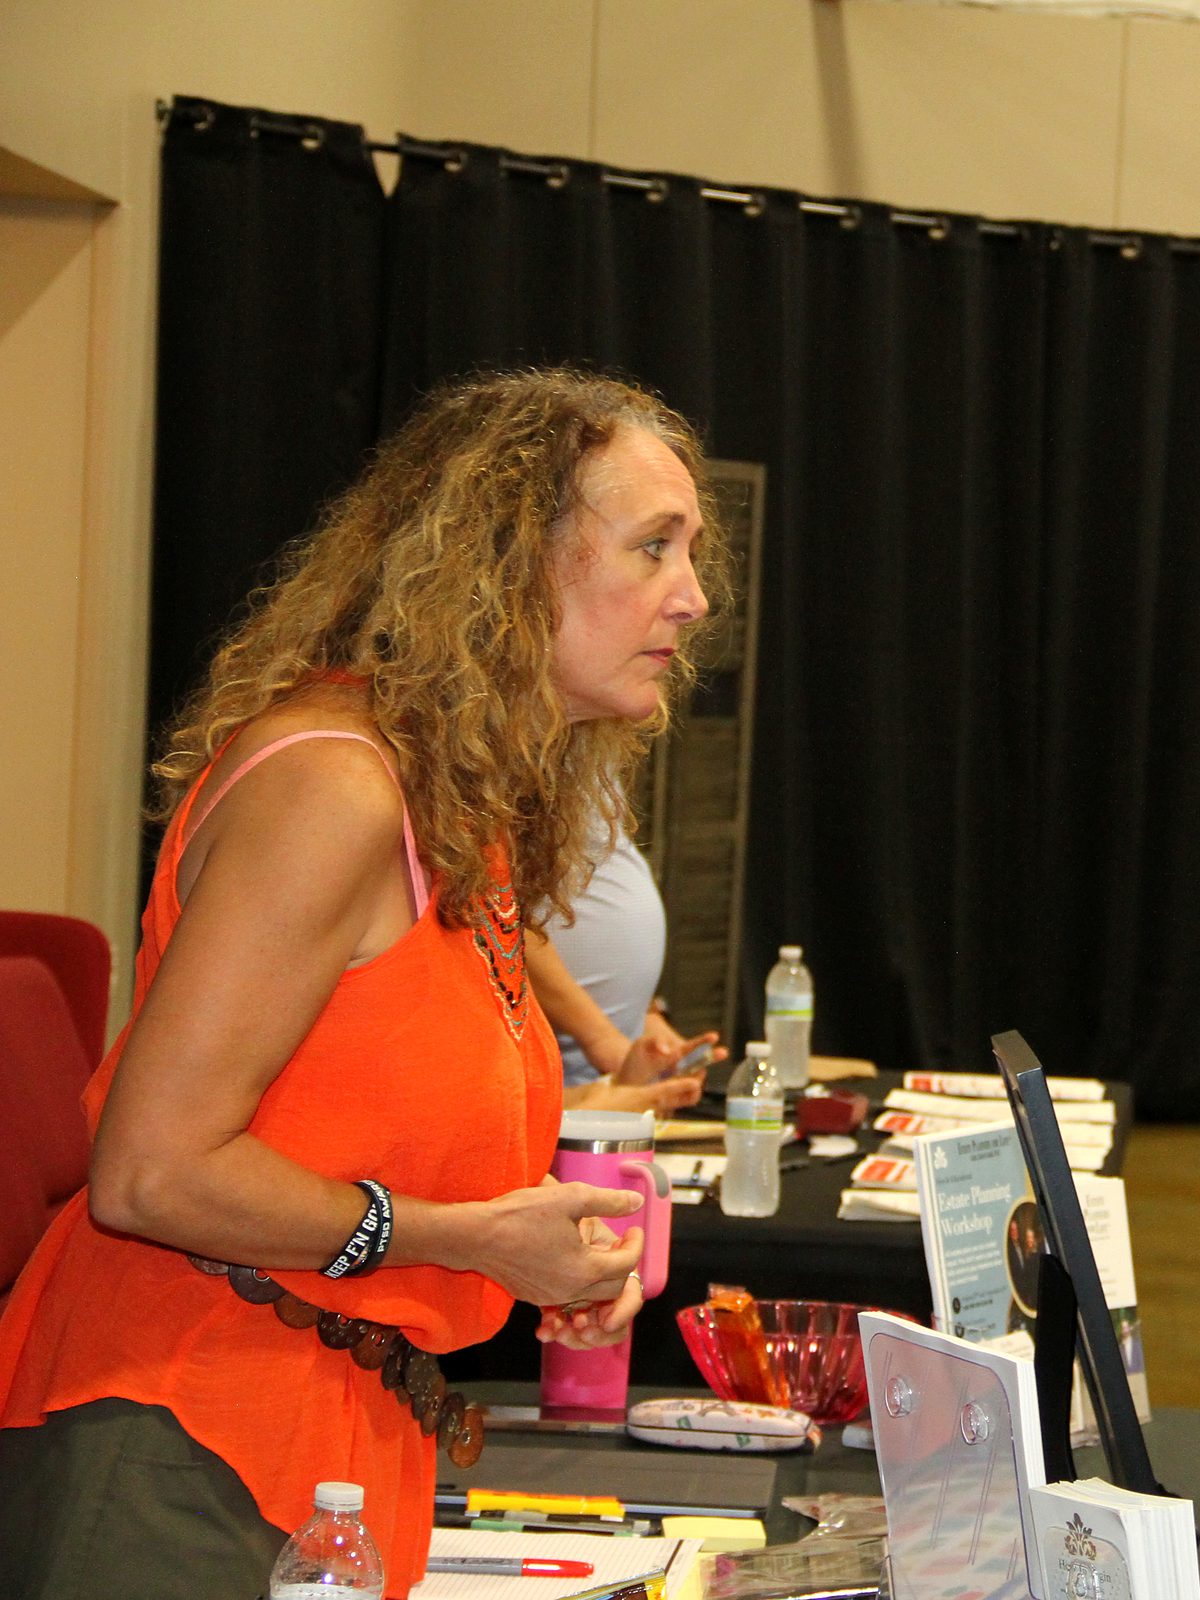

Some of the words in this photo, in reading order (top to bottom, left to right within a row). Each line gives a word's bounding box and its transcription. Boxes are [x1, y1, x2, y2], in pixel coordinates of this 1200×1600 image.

[938, 1191, 970, 1213] Estate
[970, 1183, 1011, 1206] Planning
[377, 1222, 391, 1252] PTSD
[940, 1212, 993, 1238] Workshop
[324, 1255, 350, 1279] KEEP
[345, 1232, 370, 1257] F'N
[362, 1203, 378, 1232] GO
